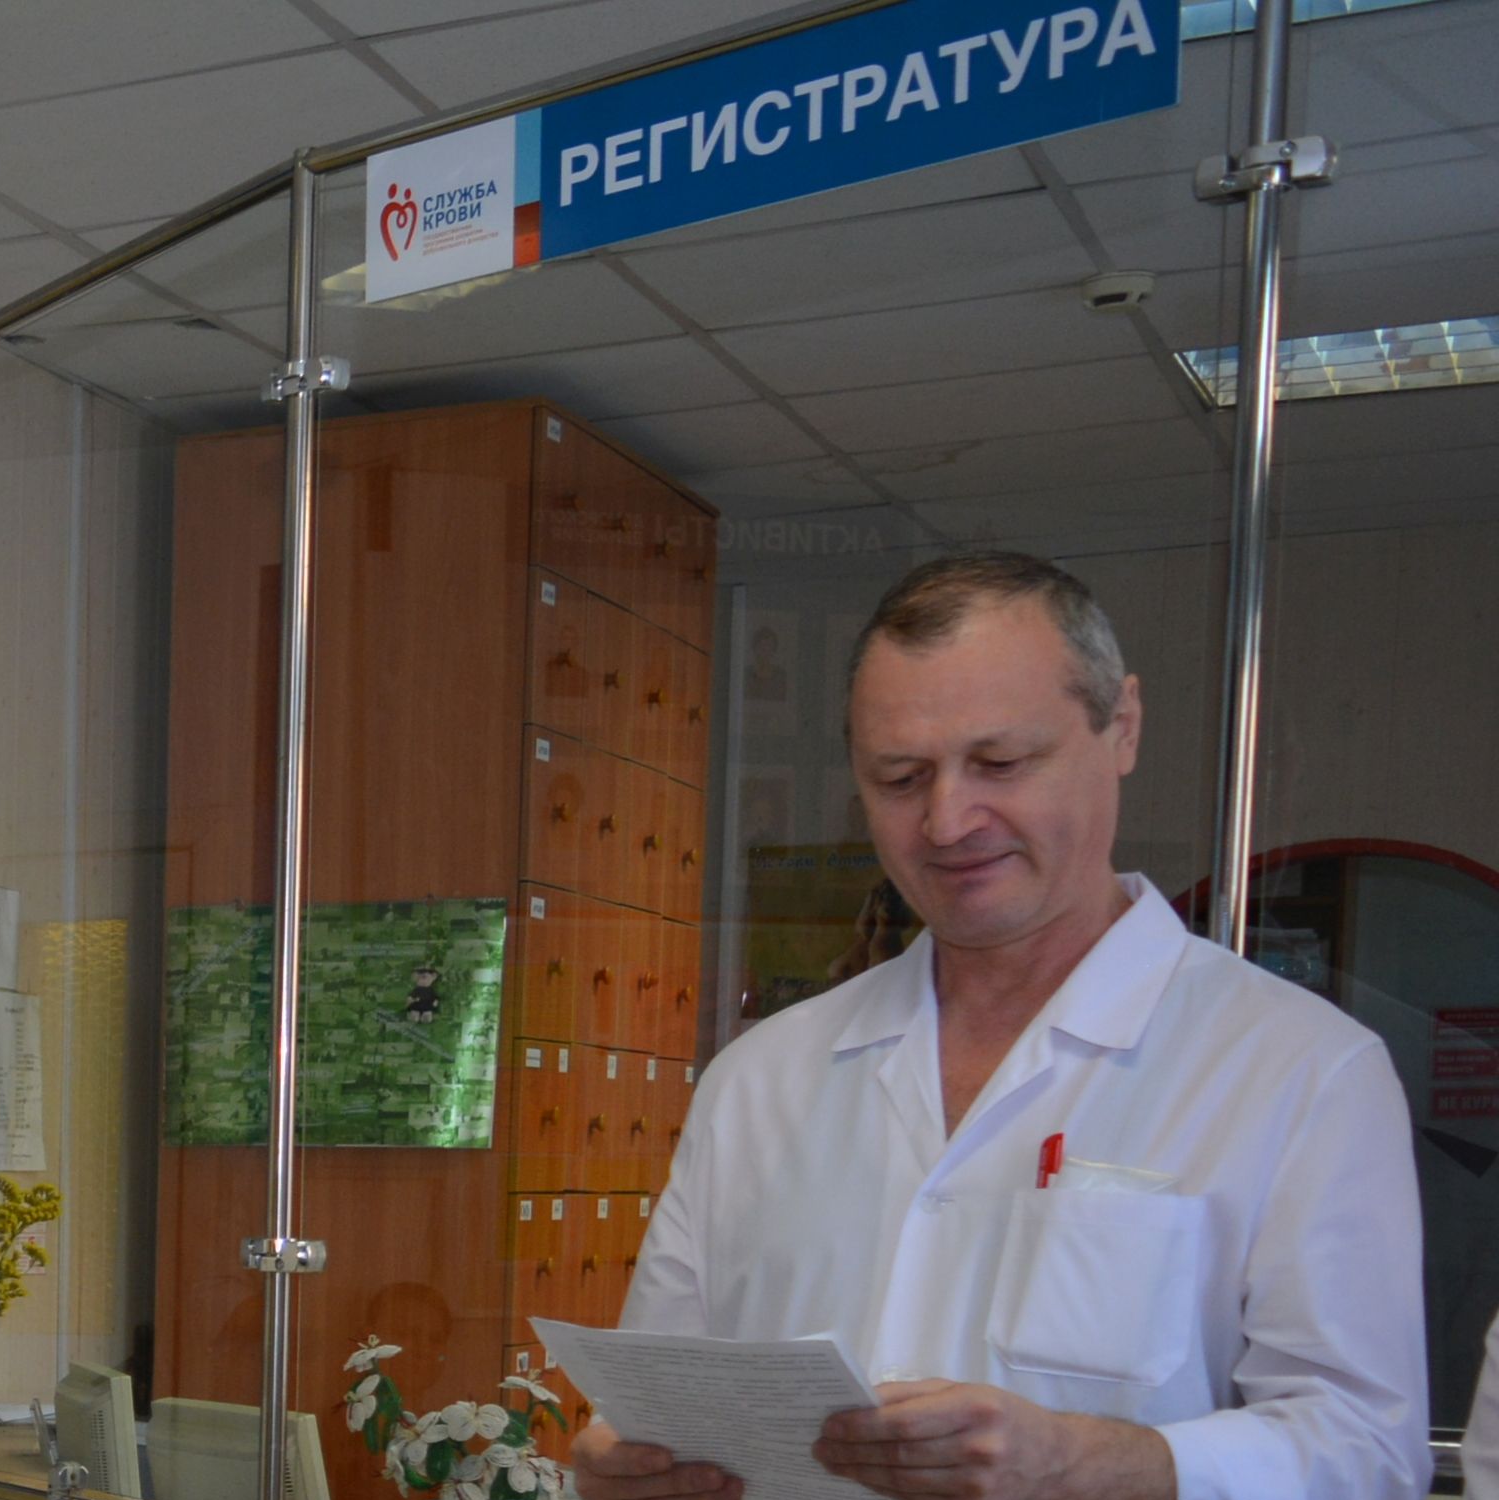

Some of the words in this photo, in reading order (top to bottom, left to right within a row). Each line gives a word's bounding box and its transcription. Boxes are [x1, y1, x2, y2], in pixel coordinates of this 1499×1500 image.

[558, 0, 1157, 207] РЕГИСТРАТУРА
[423, 180, 497, 213] СЛУЖБА
[423, 202, 481, 231] КРОВИ
